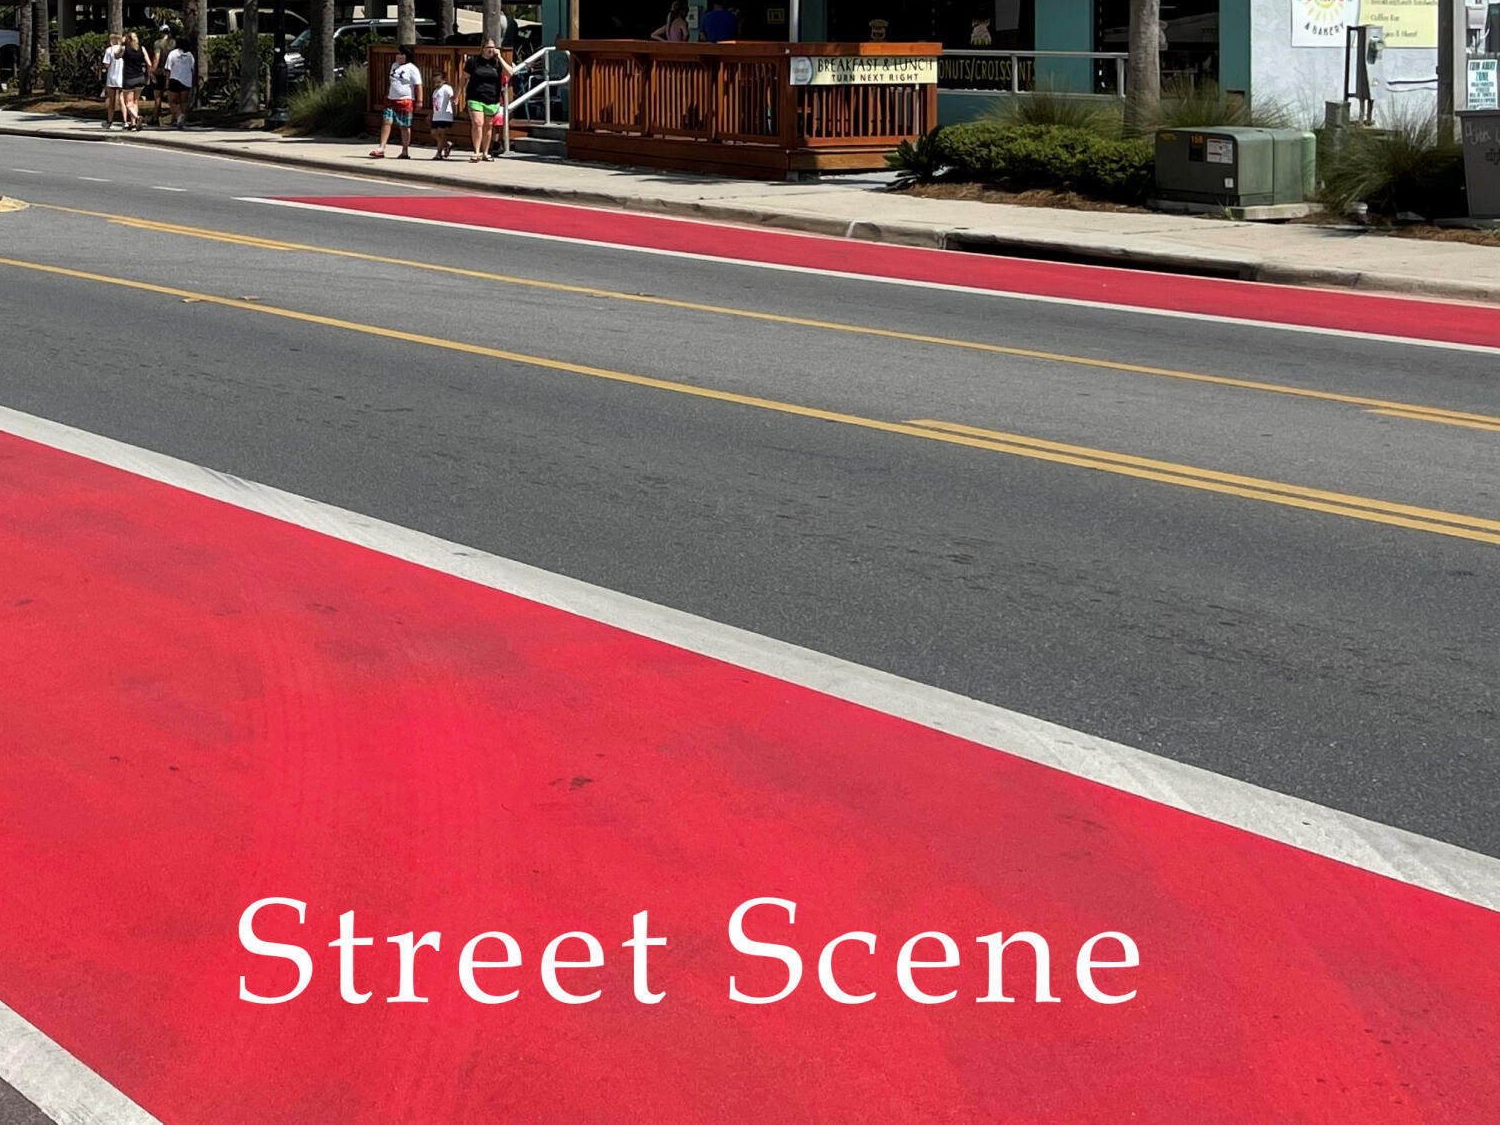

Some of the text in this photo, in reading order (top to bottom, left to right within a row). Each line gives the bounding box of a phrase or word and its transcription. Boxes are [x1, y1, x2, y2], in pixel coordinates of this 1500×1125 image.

[1312, 21, 1345, 36] BAKERY
[817, 58, 878, 73] BREAKFAST
[882, 58, 890, 72] &
[893, 58, 933, 71] LUNCH
[859, 74, 884, 82] NEXT
